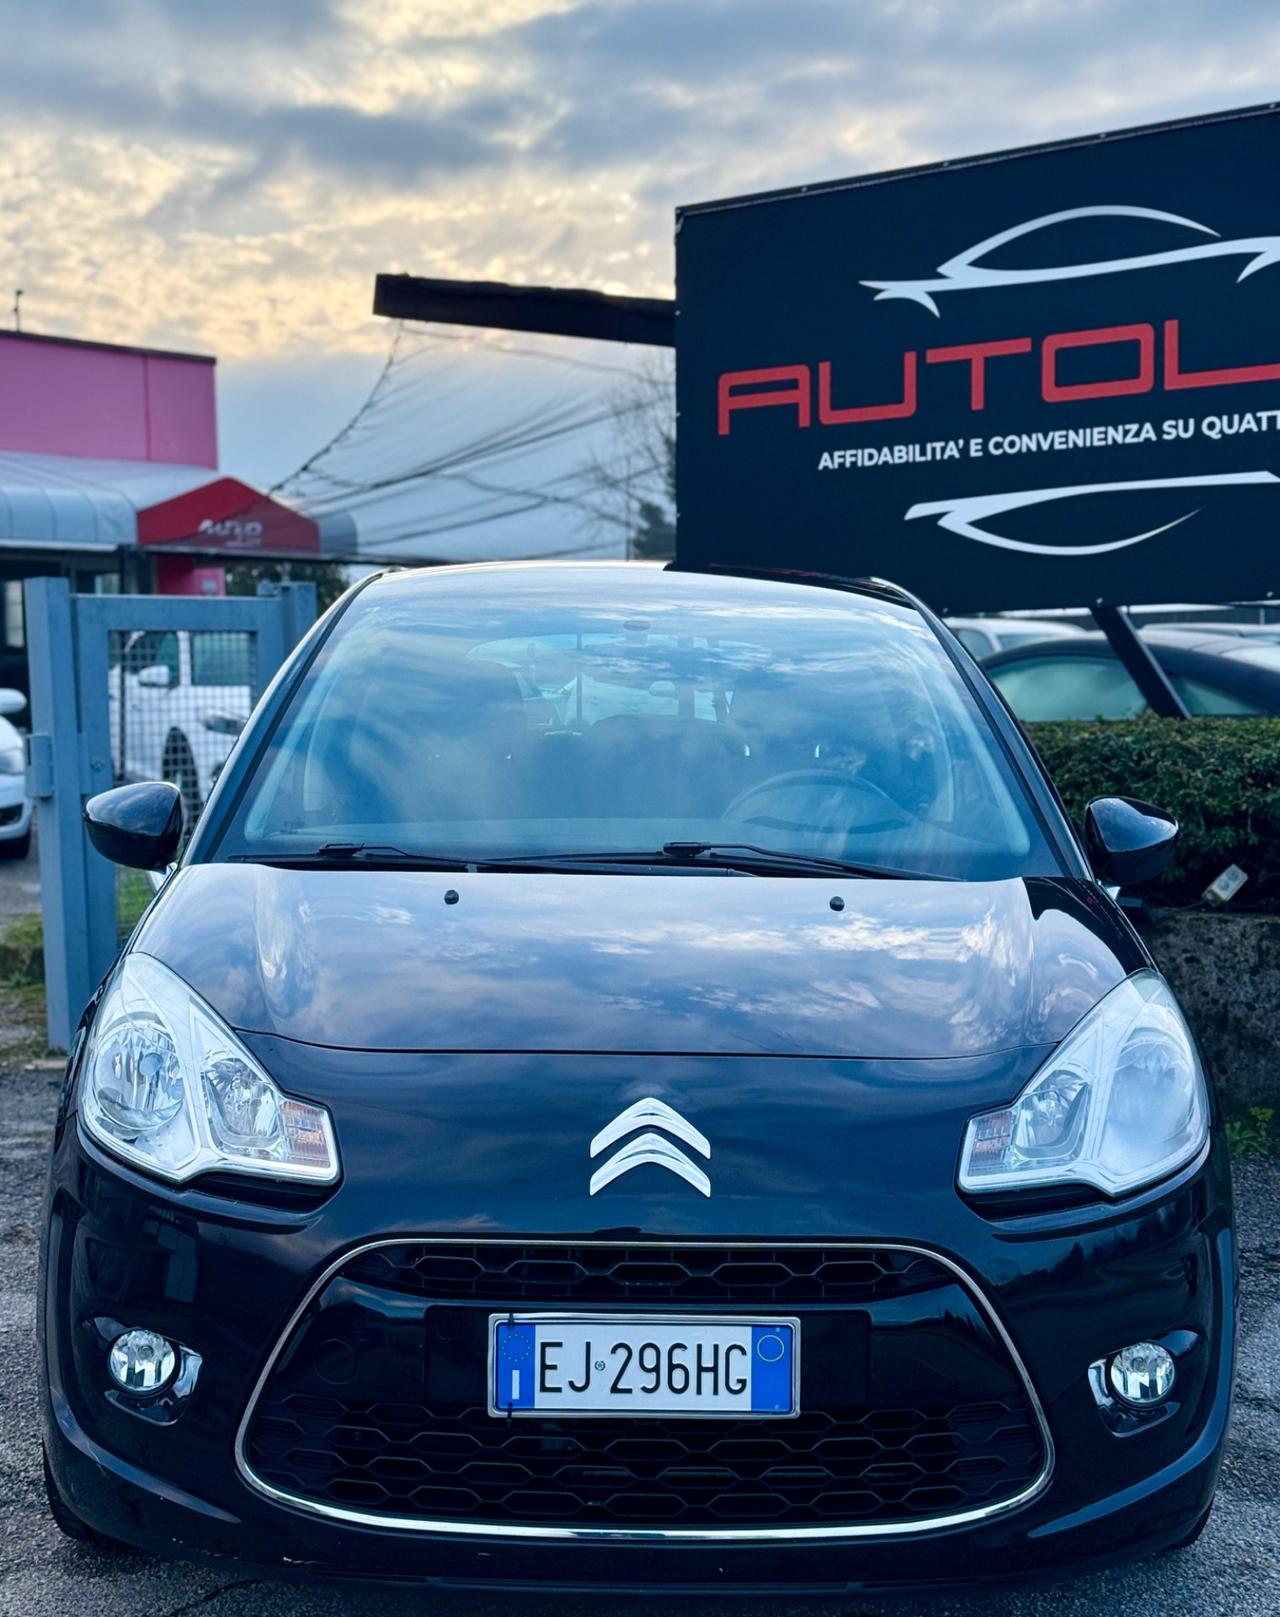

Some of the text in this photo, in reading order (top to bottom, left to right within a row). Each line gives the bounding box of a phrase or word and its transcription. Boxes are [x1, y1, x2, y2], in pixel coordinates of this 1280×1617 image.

[969, 438, 983, 457] E
[988, 422, 1157, 455] CONVENIENZA
[1162, 418, 1195, 440] SU
